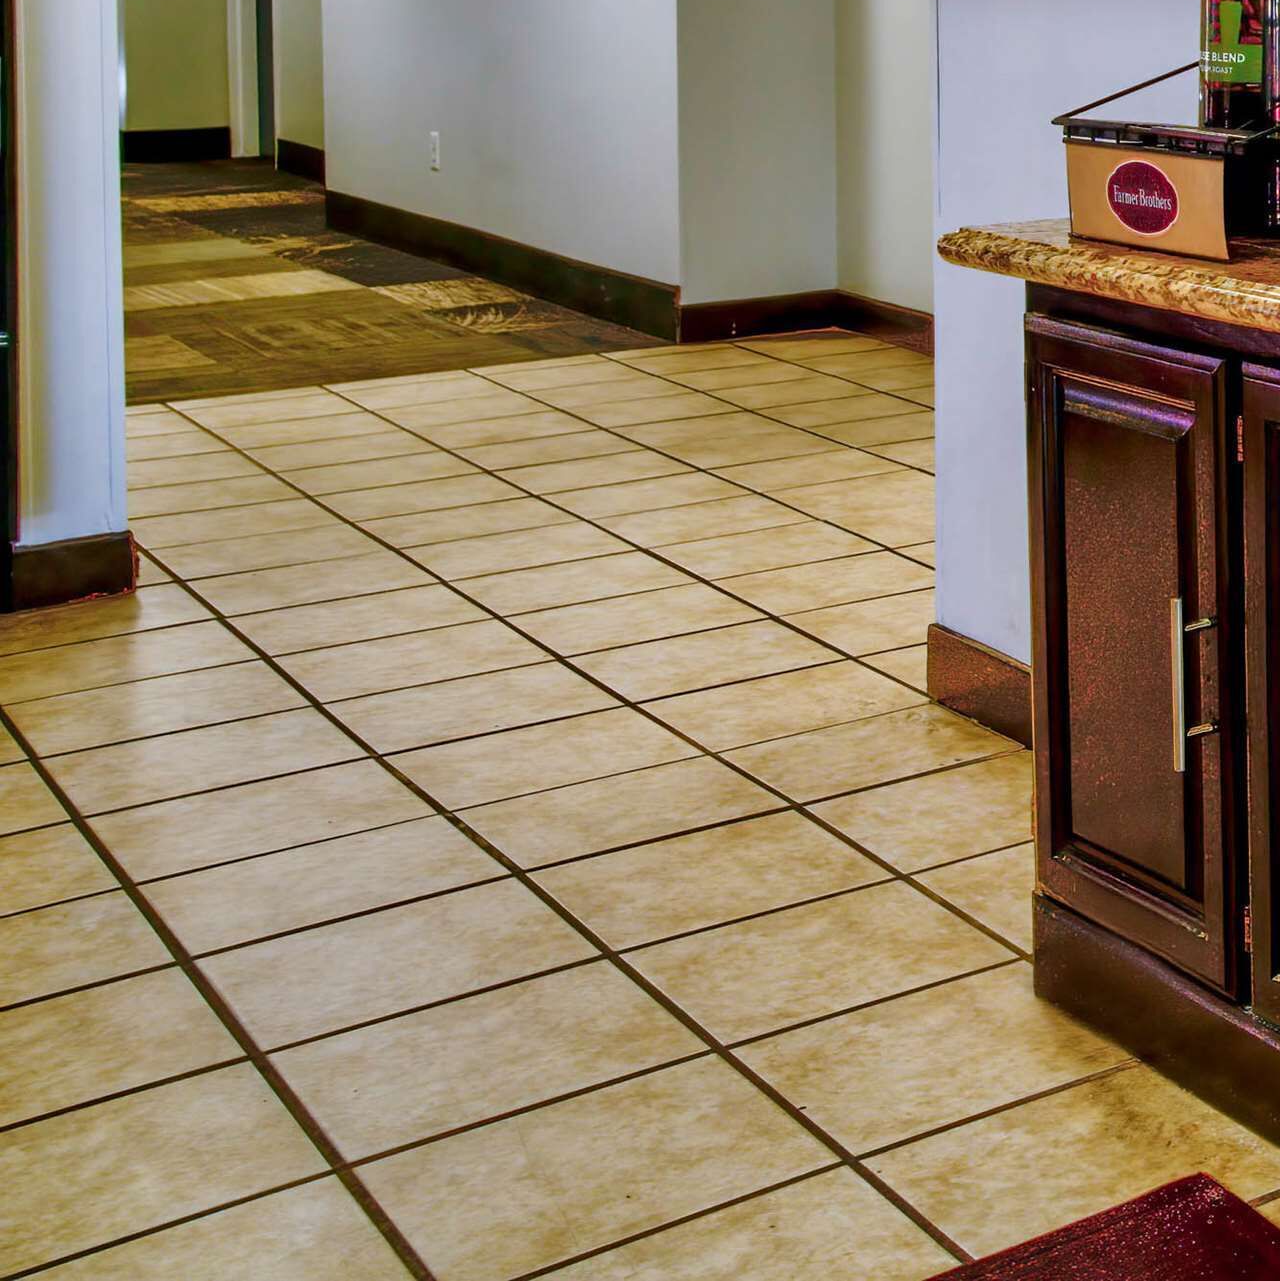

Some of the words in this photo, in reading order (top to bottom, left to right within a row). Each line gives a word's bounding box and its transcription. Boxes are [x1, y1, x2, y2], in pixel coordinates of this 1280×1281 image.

[1211, 52, 1245, 63] BLEND
[1113, 184, 1139, 205] Farmer
[1139, 188, 1172, 211] Brothers
